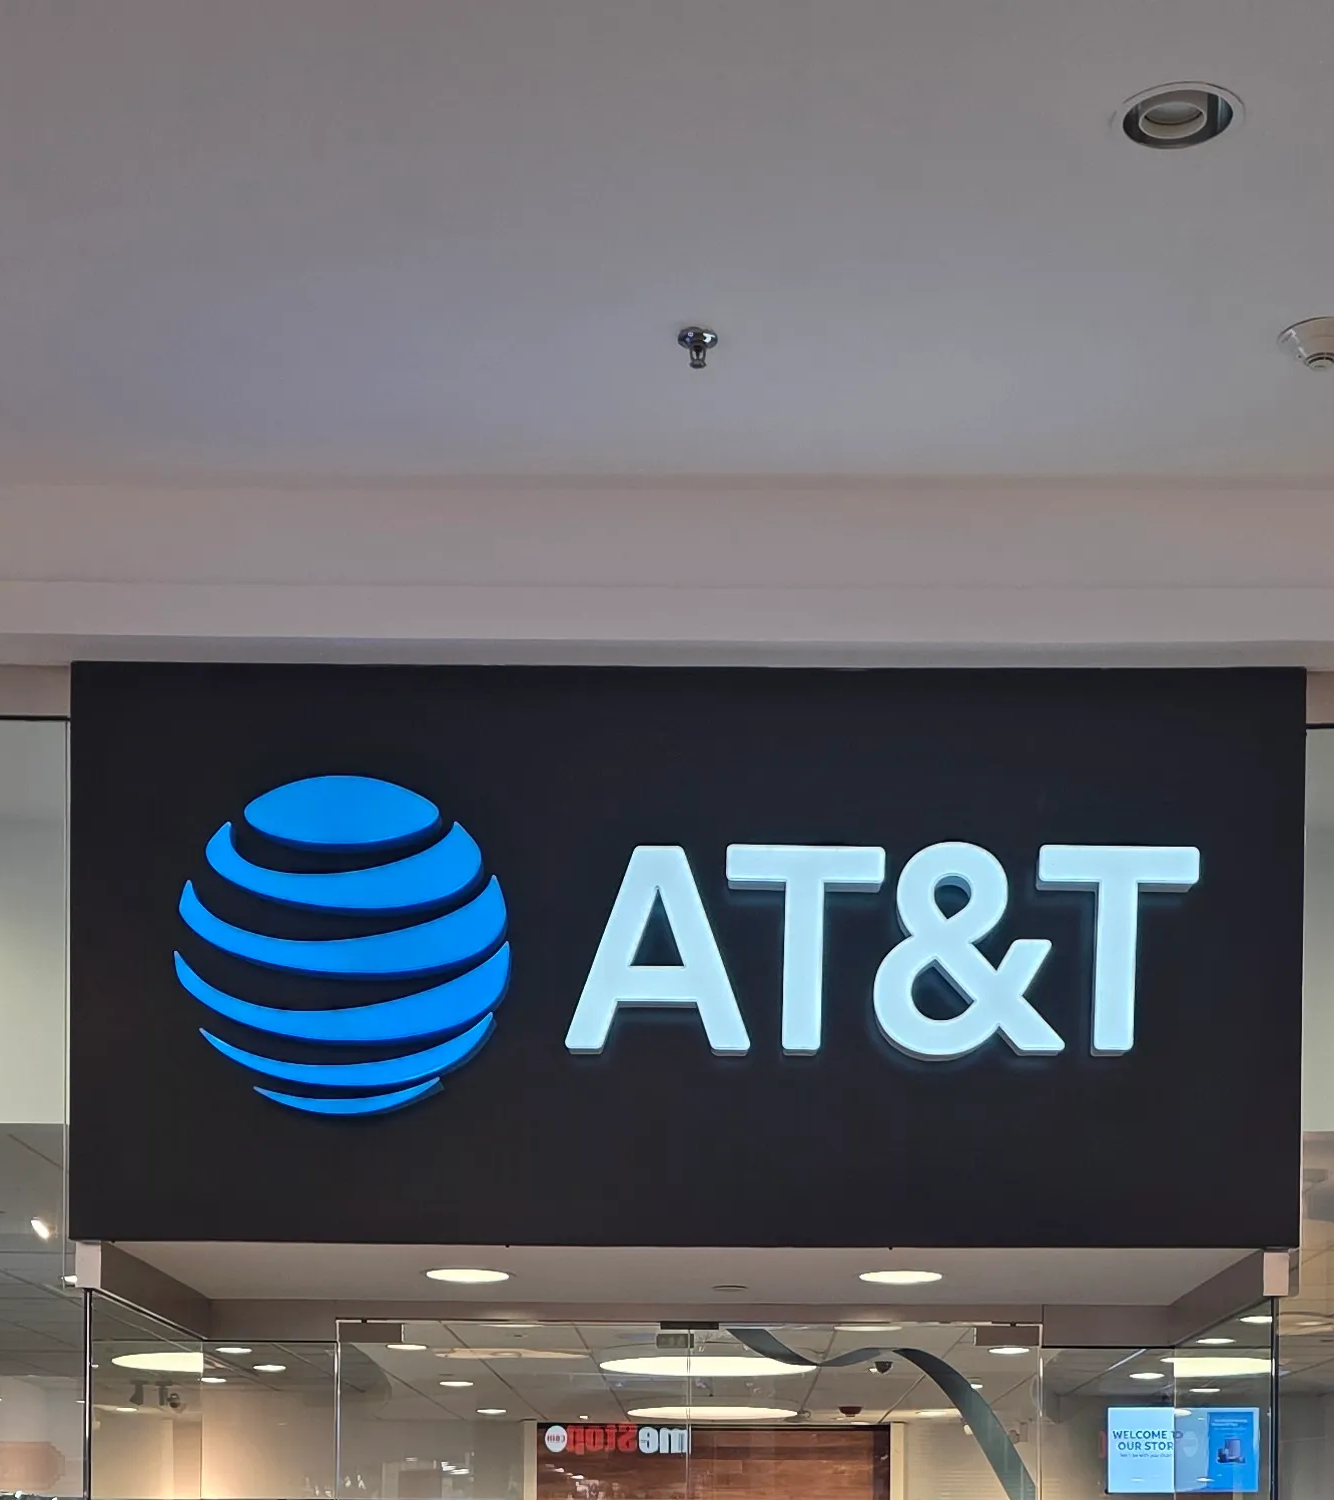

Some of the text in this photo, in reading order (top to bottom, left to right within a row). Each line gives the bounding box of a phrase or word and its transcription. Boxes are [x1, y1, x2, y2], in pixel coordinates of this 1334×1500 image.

[564, 840, 1203, 1062] AT&T
[1112, 1430, 1168, 1440] WELCOME
[1118, 1441, 1142, 1451] OUR
